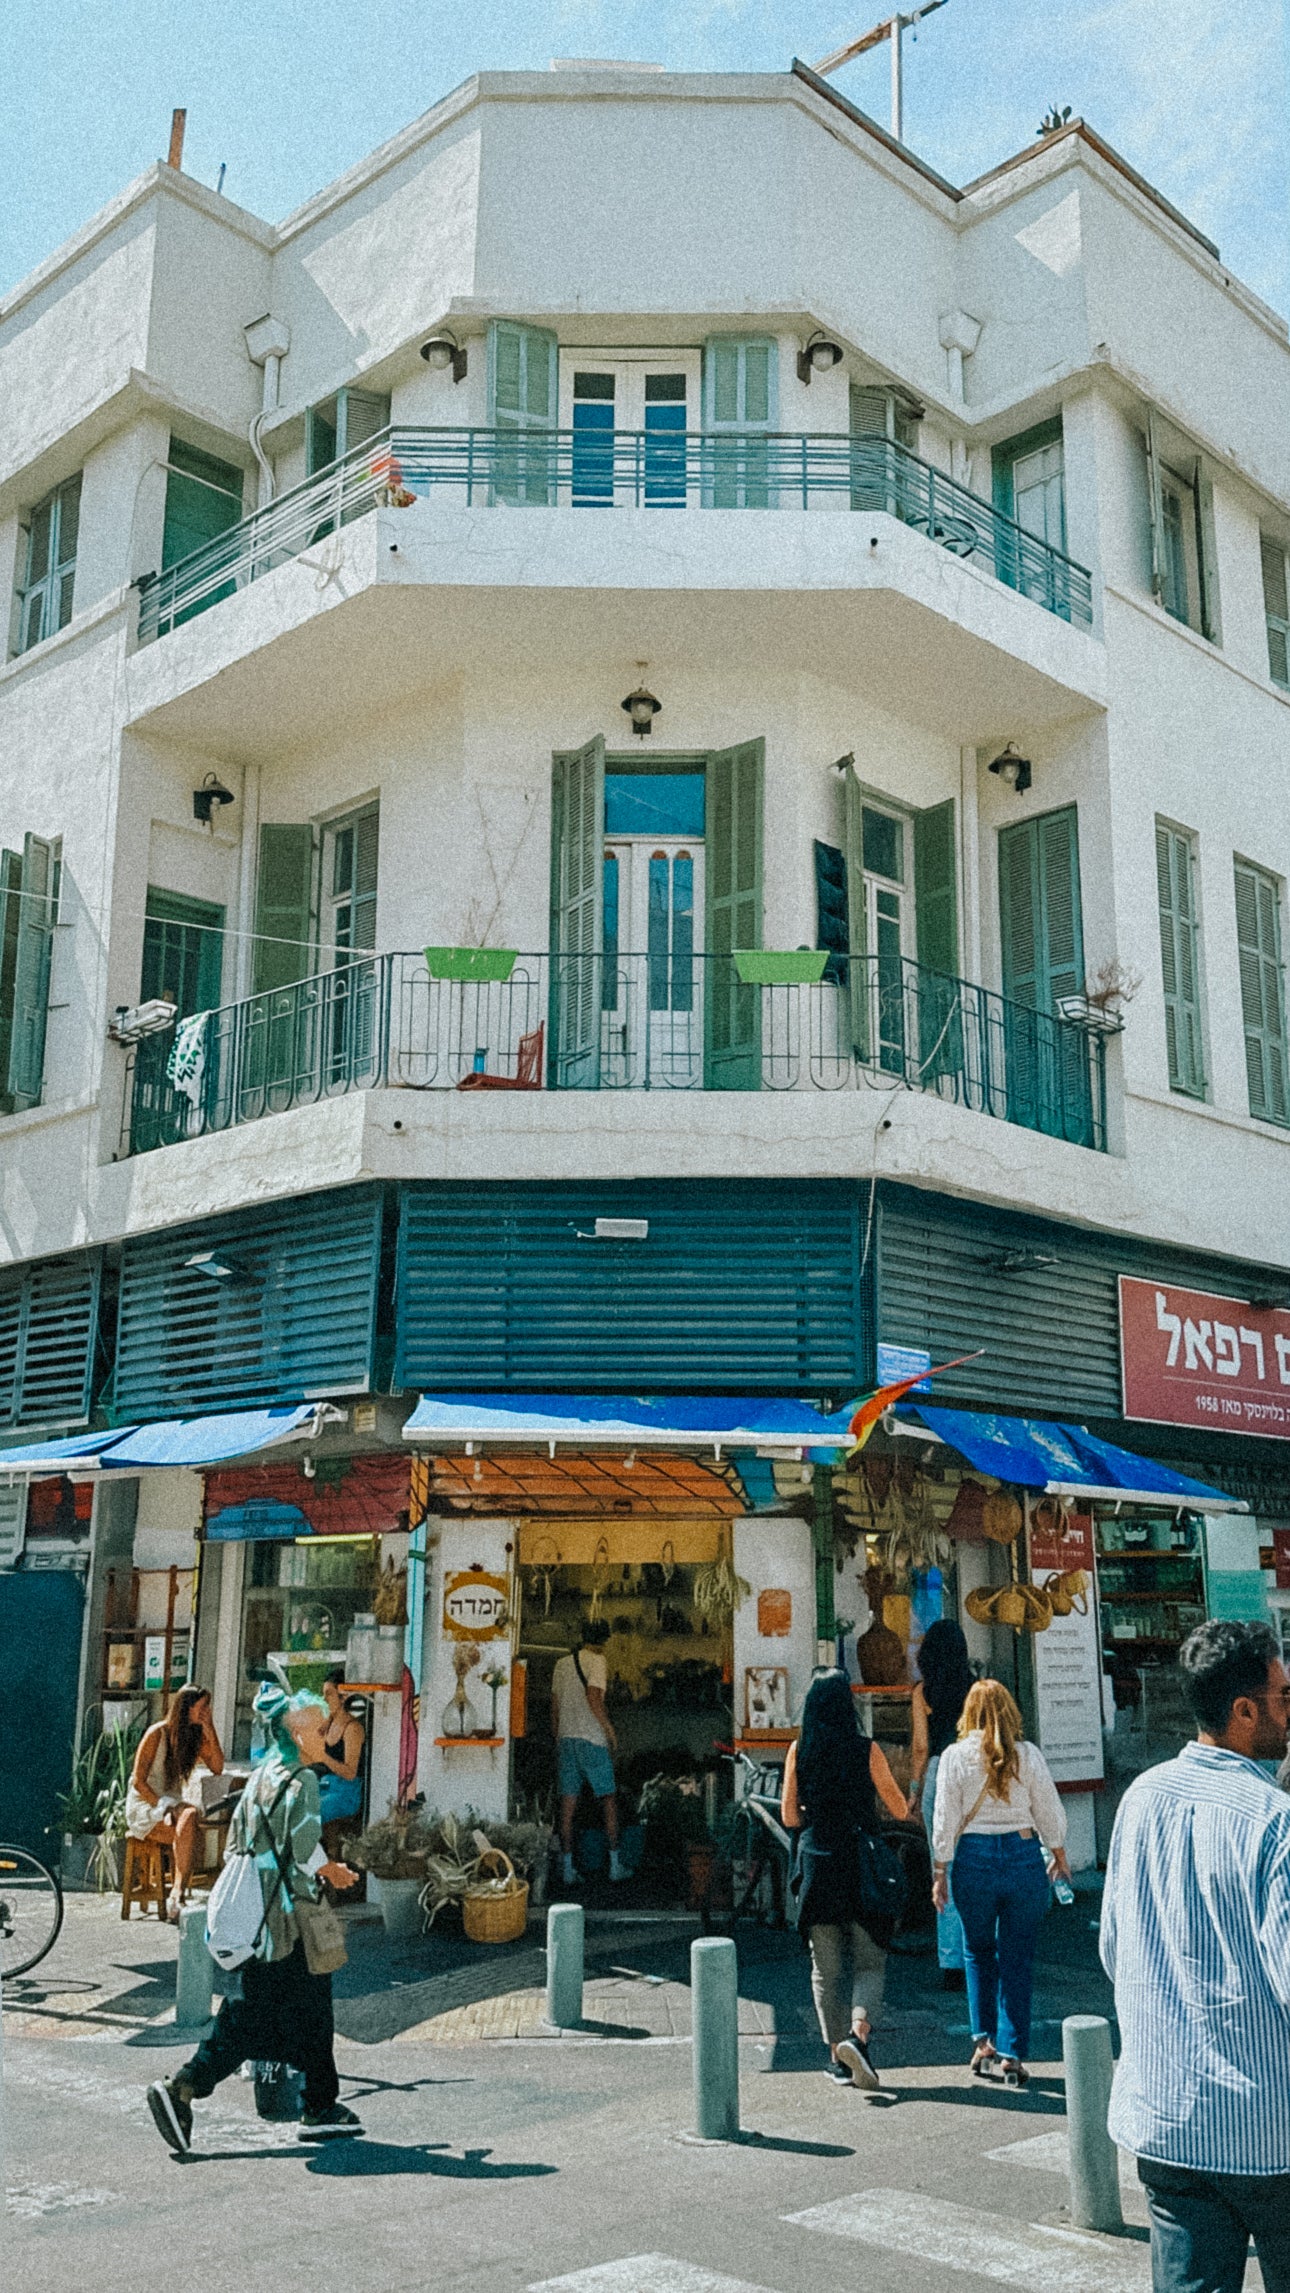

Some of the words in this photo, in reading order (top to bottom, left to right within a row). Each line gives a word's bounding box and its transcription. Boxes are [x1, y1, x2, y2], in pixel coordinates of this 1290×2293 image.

[1155, 1291, 1266, 1380] רפאל
[1196, 1395, 1219, 1412] 1958
[1221, 1399, 1242, 1416] מאז
